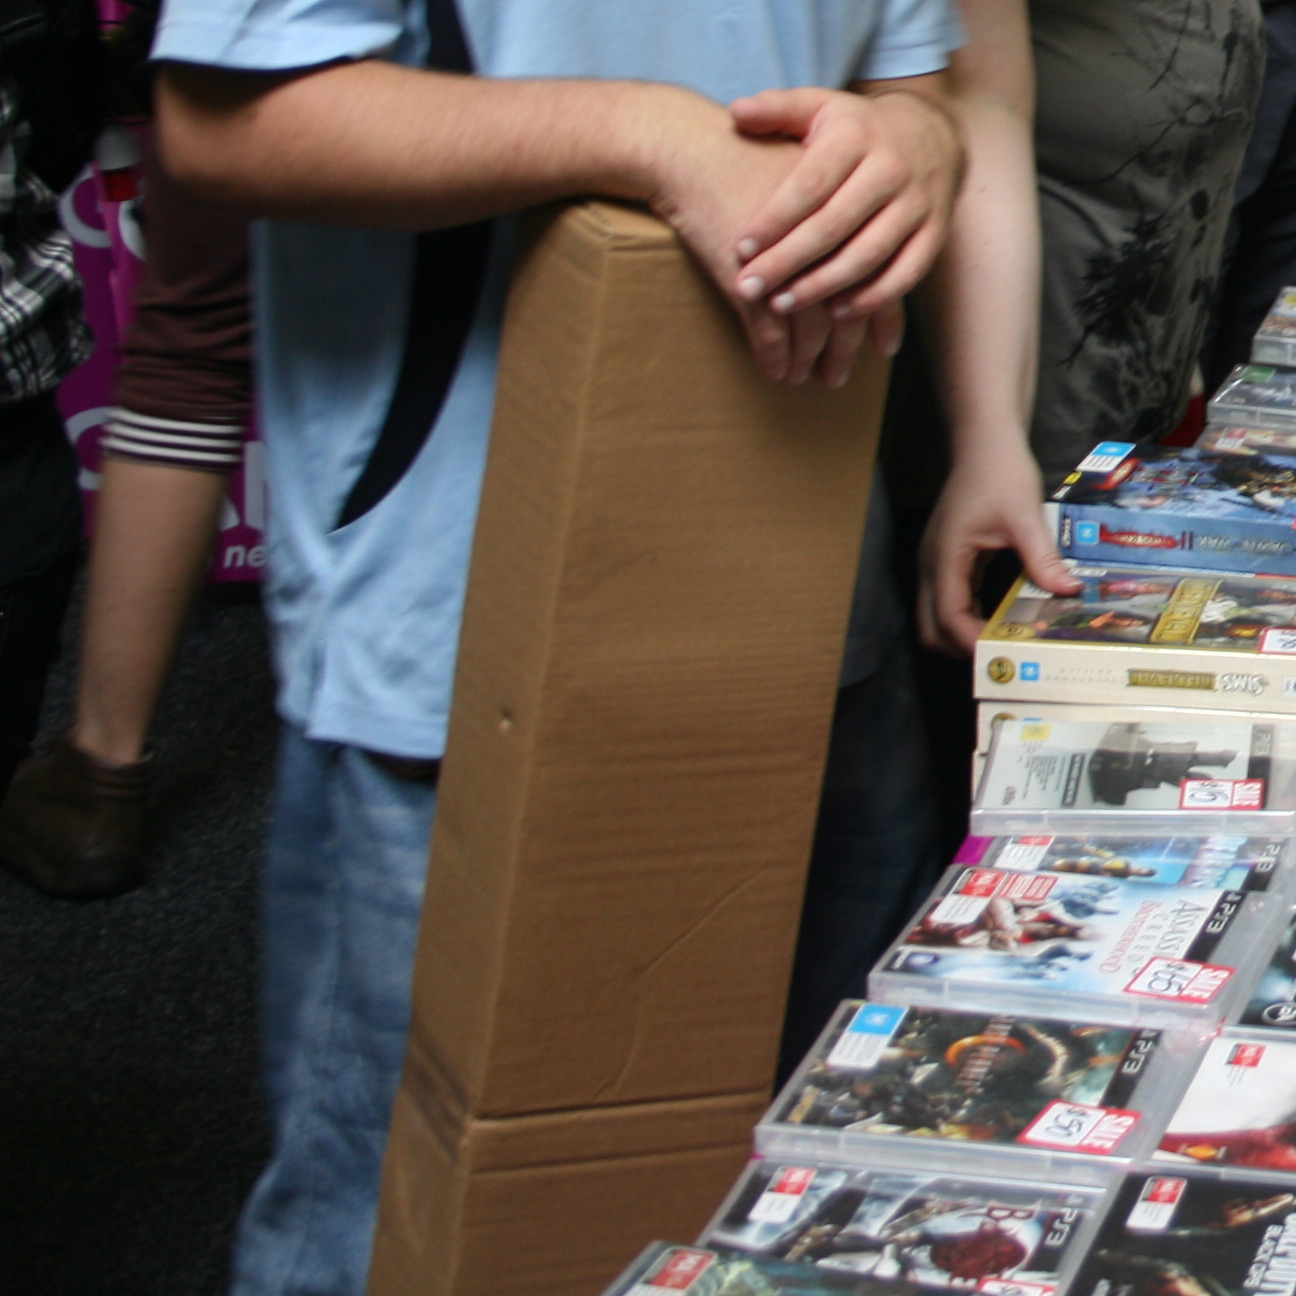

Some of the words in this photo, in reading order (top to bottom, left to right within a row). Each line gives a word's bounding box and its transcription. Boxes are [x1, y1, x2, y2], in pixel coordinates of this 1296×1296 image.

[1220, 673, 1267, 695] SIMS
[1256, 840, 1281, 873] PS3
[1205, 902, 1238, 934] PS3
[1185, 966, 1233, 1002] SALE
[1121, 1039, 1154, 1075] PS3
[1080, 1113, 1136, 1149] SALE
[1043, 1207, 1080, 1247] PS3
